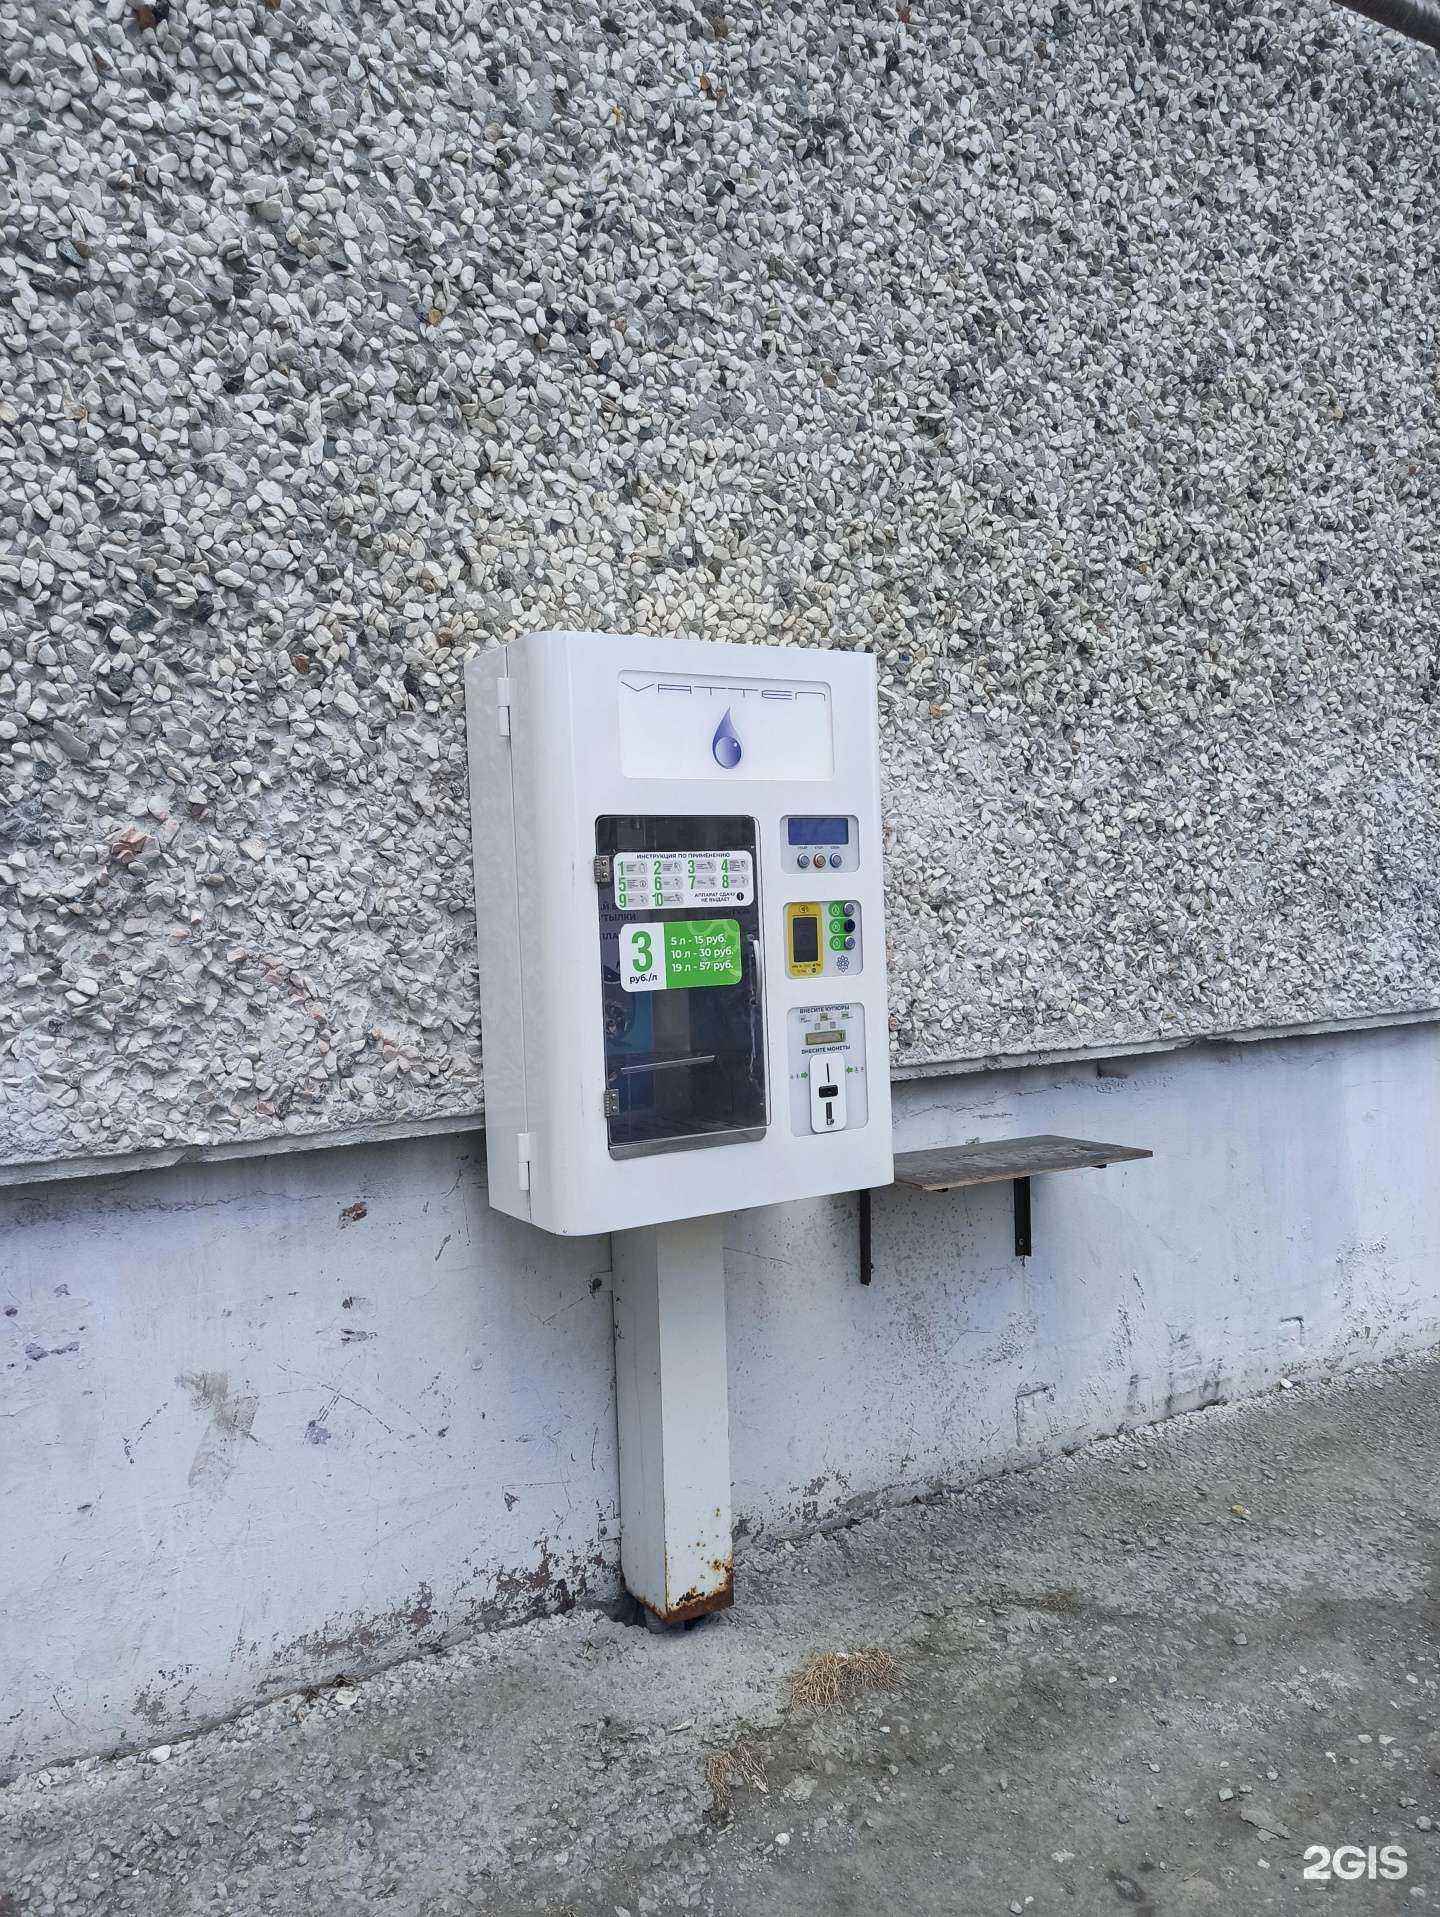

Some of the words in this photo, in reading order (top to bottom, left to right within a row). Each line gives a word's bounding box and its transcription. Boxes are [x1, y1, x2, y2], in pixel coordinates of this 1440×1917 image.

[618, 861, 625, 876] 1
[653, 860, 662, 875] 2
[687, 859, 696, 874] 3
[721, 859, 729, 873] 4
[618, 877, 626, 892] 5
[654, 876, 662, 890] 6
[687, 875, 696, 889] 7
[721, 875, 729, 889] 8
[618, 893, 627, 908] 9
[652, 892, 664, 907] 10
[670, 936, 678, 946] 5
[679, 937, 686, 945] л
[694, 935, 705, 944] 15
[706, 933, 727, 947] руб.
[631, 930, 653, 973] 3
[671, 950, 682, 959] 10
[683, 951, 691, 959] л
[699, 948, 712, 957] 30
[713, 946, 734, 960] руб.
[671, 963, 683, 972] 19
[683, 964, 691, 972] л
[699, 961, 711, 971] 57
[713, 959, 734, 973] руб.
[629, 973, 658, 985] руб./л
[800, 1006, 823, 1014] ВНЕСИТЕ
[801, 1047, 825, 1055] ВНЕСИТЕ
[826, 1045, 851, 1054] МОНЕТЫ
